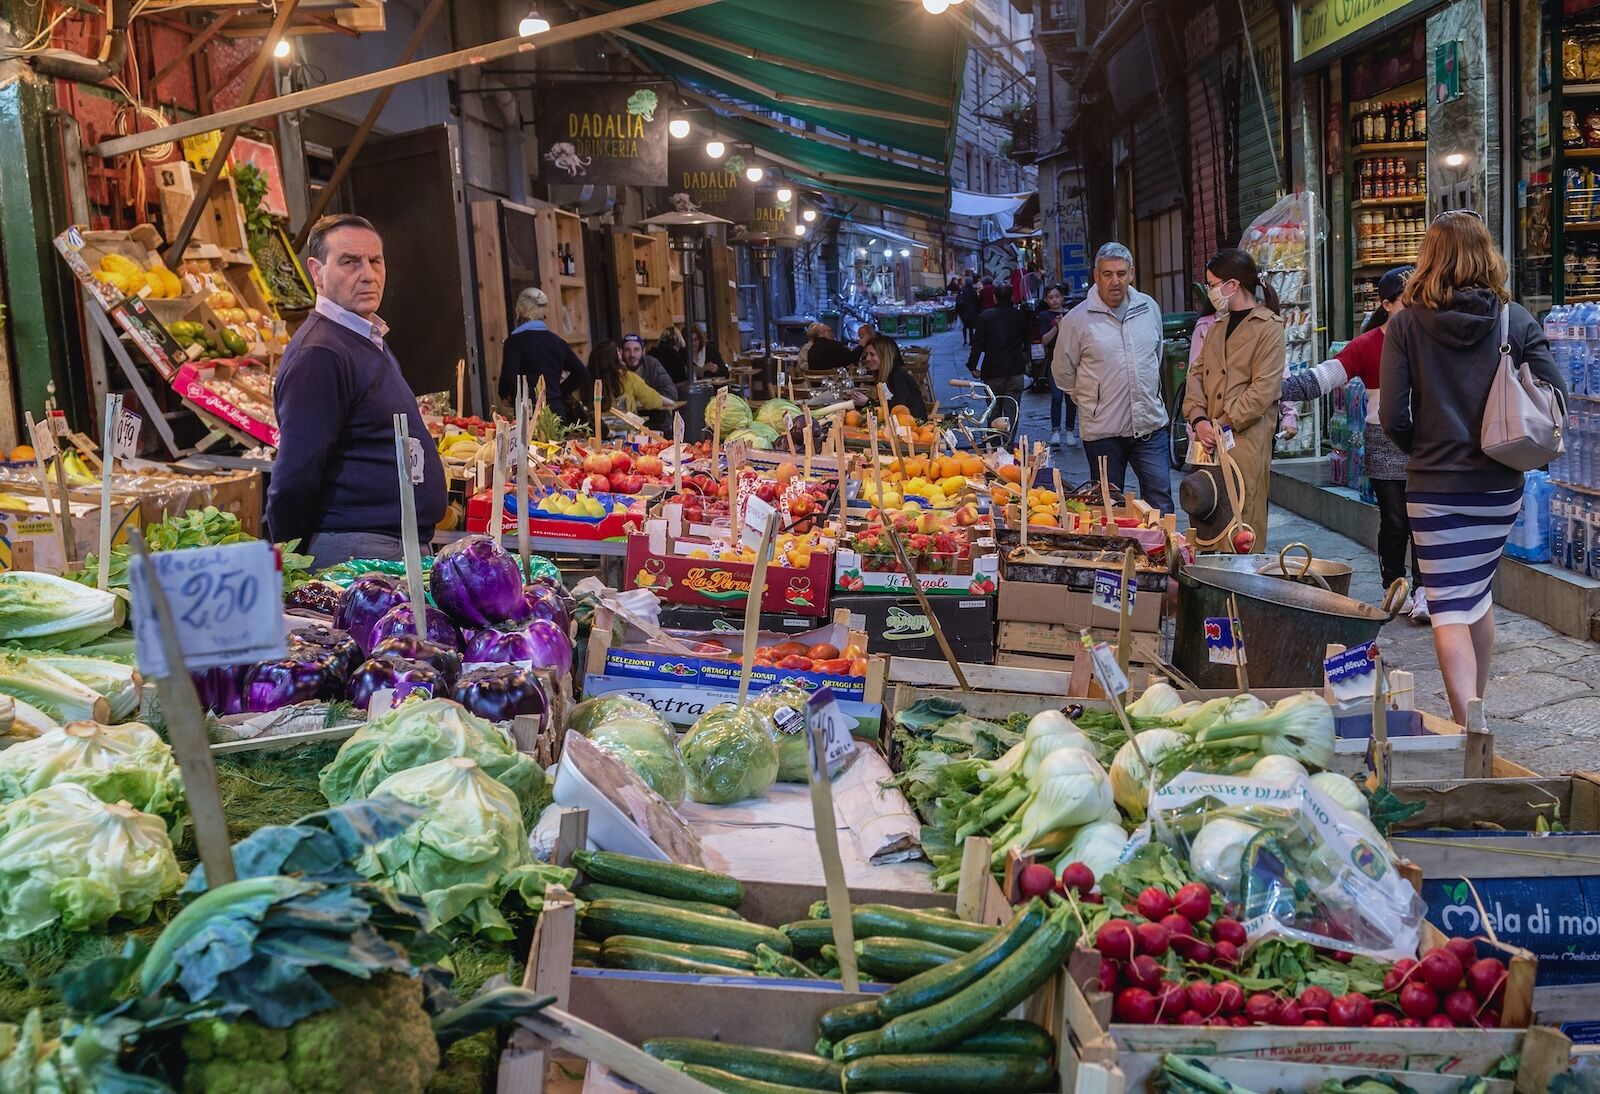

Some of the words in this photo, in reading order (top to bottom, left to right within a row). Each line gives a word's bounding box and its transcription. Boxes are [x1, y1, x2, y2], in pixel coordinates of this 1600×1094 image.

[568, 113, 644, 138] DADALIA
[577, 139, 638, 158] DRINKERIA
[683, 170, 737, 189] DADALIA
[756, 207, 785, 221] DALIA
[611, 655, 655, 667] SELEZIONATI
[701, 667, 732, 678] ORTAGGI
[733, 669, 776, 681] SEZIONATI
[822, 679, 852, 688] ORTAGGI
[627, 691, 705, 715] Extra
[1442, 902, 1521, 934] Mela
[1527, 903, 1550, 934] di
